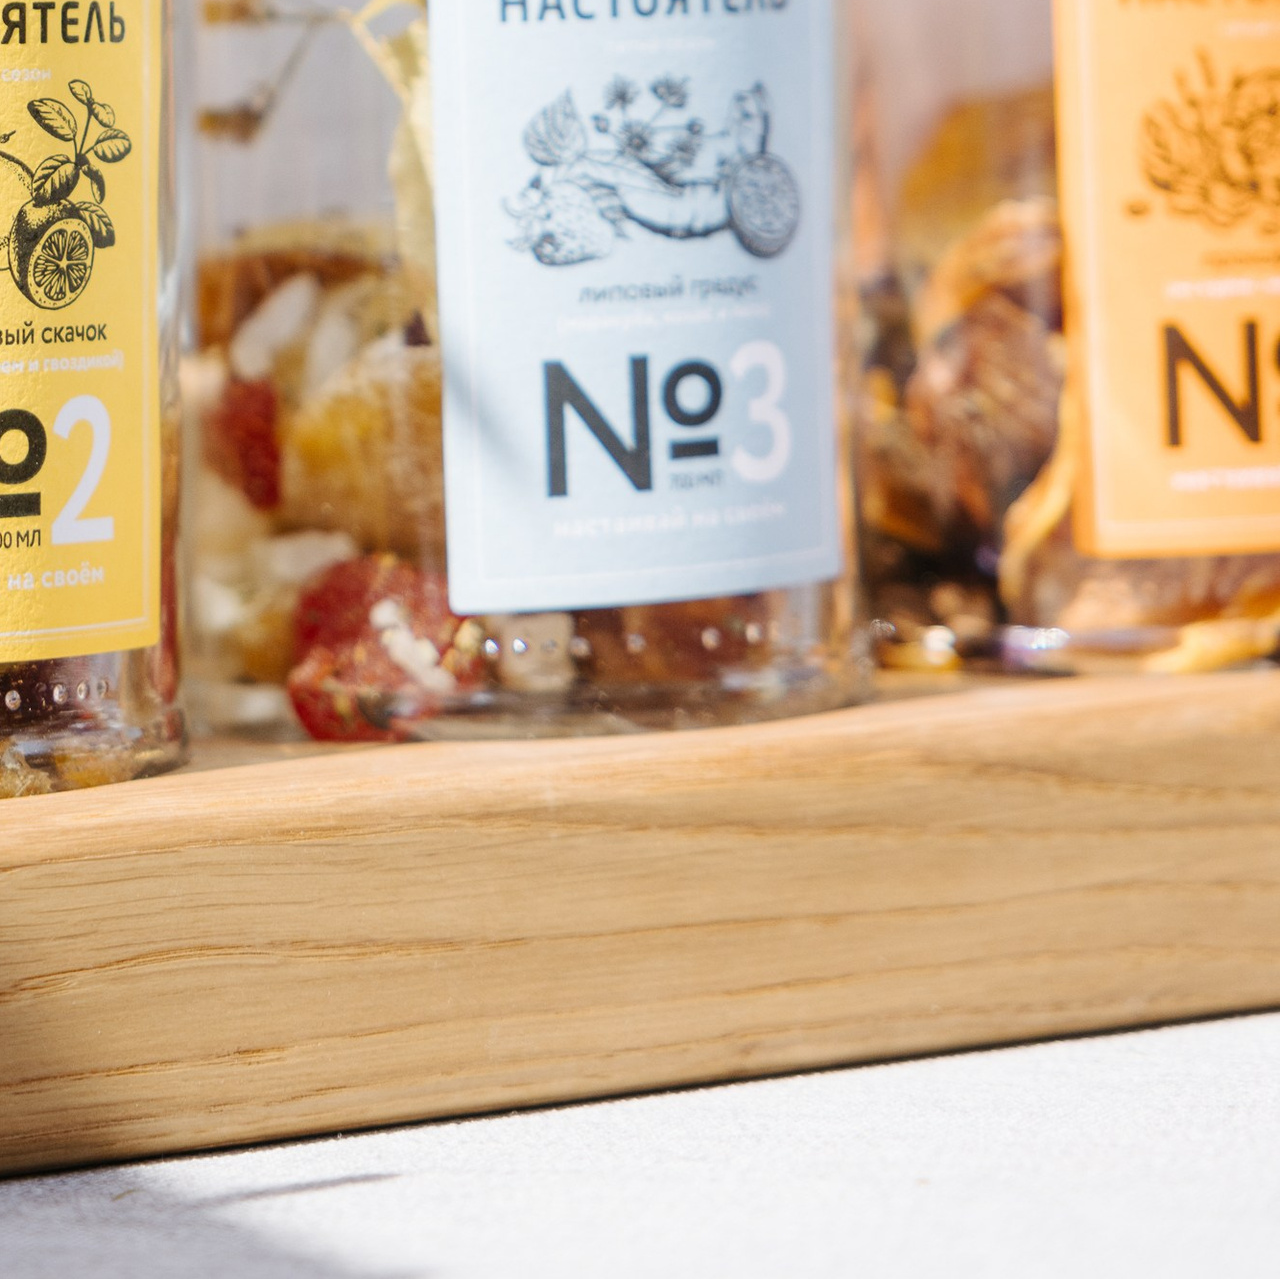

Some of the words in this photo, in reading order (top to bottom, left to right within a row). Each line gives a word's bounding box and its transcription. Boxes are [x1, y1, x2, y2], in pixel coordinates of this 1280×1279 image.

[1, 67, 52, 82] сезон
[41, 323, 108, 344] скачок
[28, 357, 39, 372] и
[43, 348, 125, 372] гвоздикой)
[16, 529, 41, 548] МЛ
[7, 571, 34, 590] на
[41, 561, 105, 588] своём
